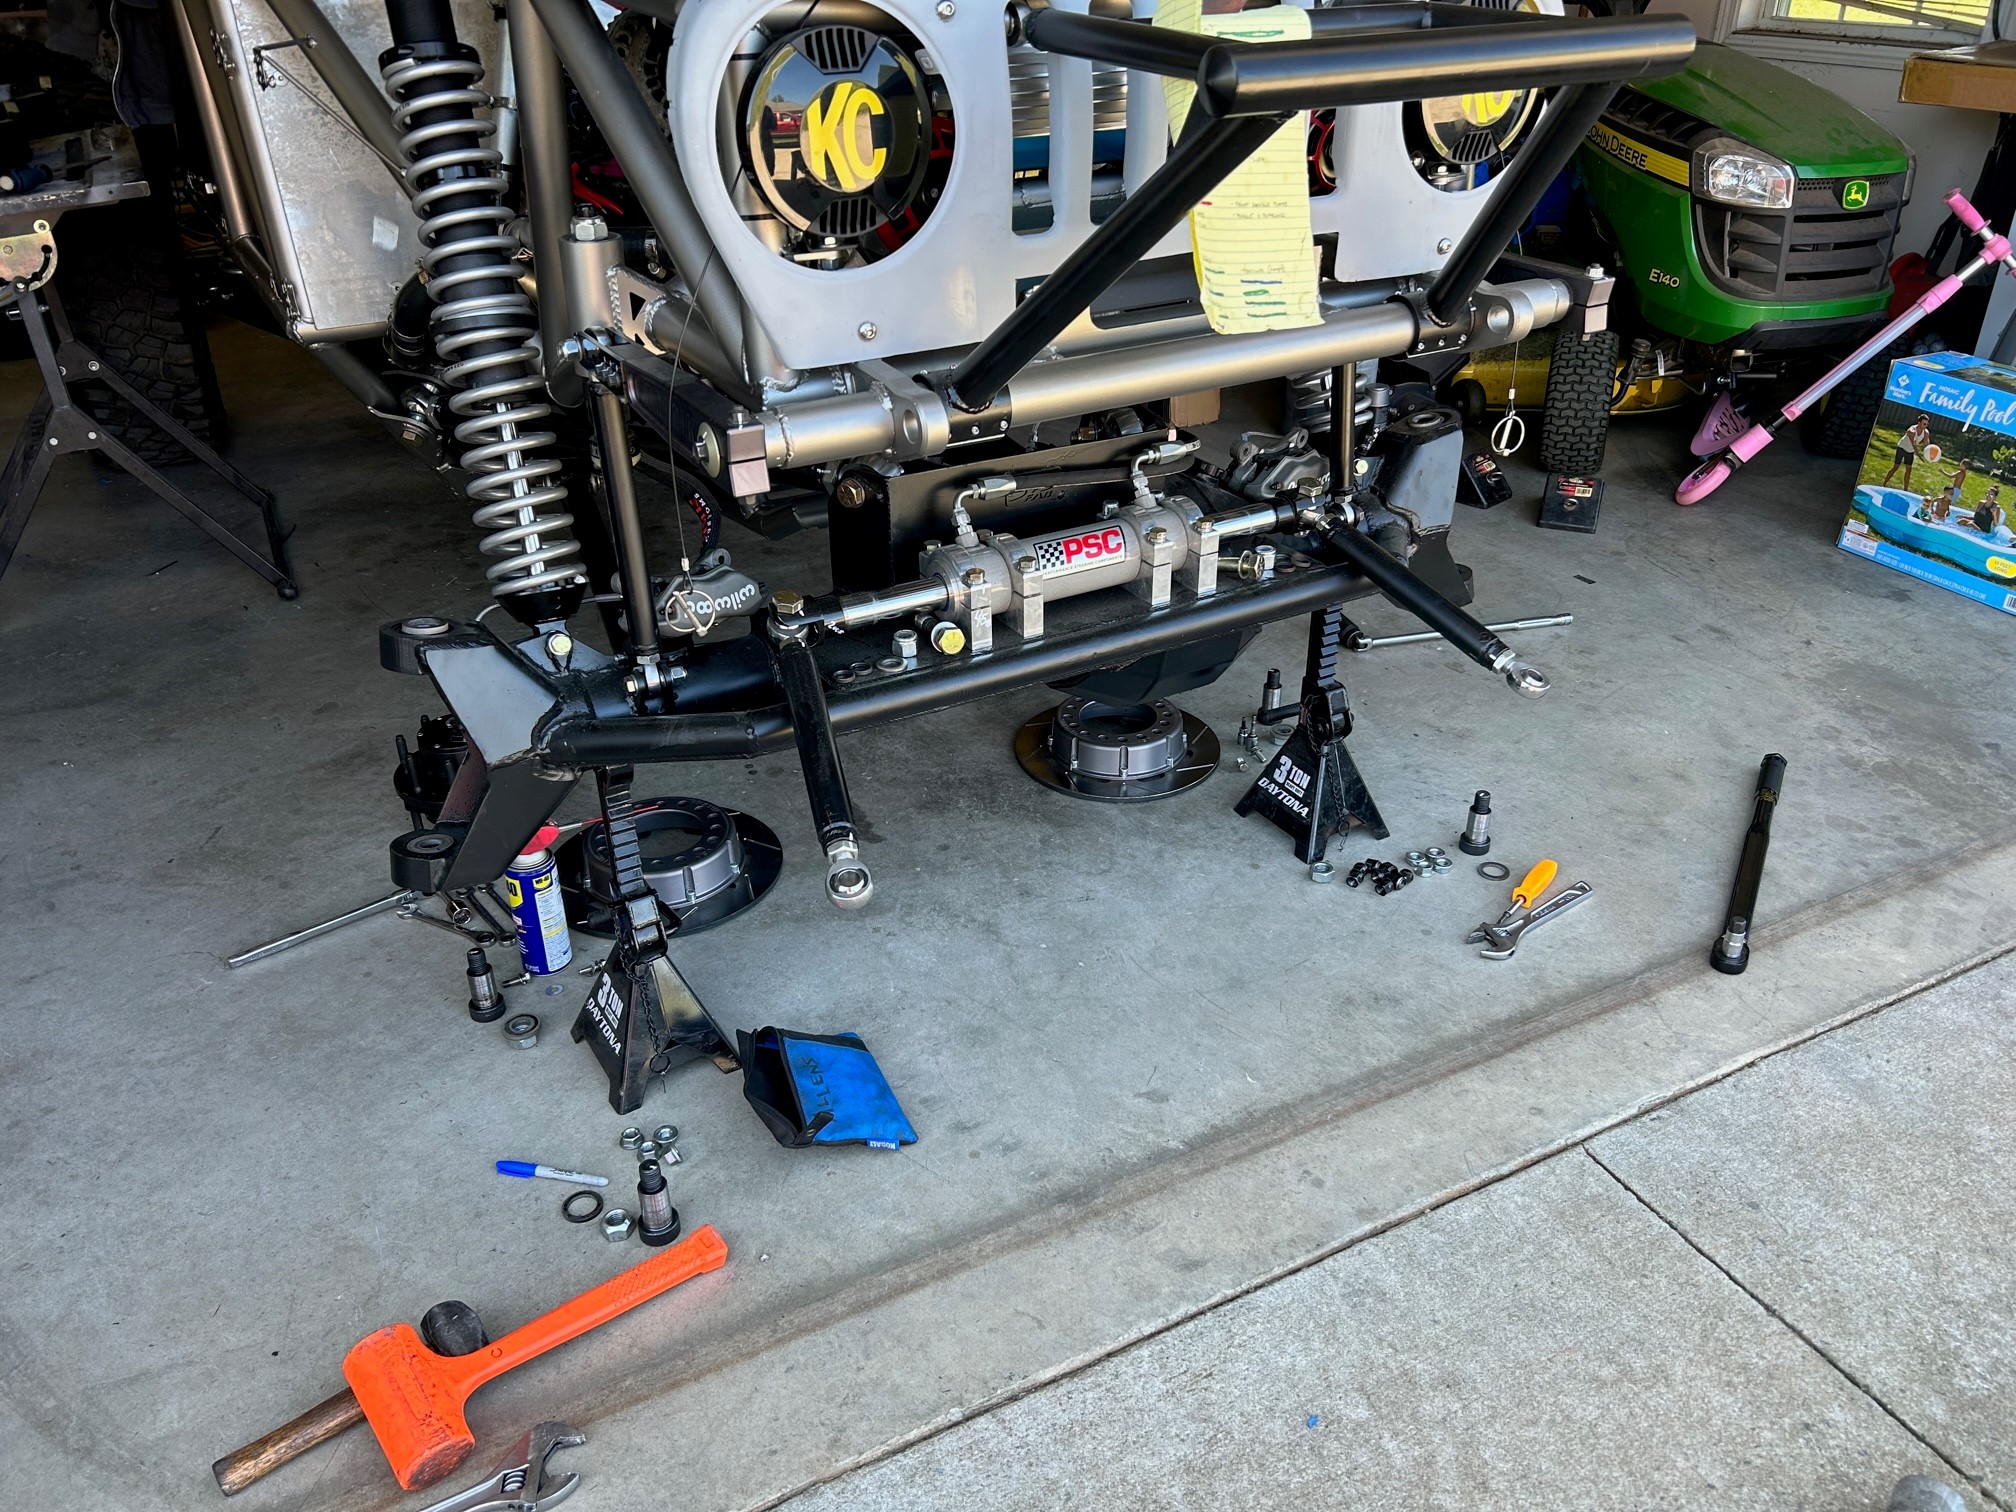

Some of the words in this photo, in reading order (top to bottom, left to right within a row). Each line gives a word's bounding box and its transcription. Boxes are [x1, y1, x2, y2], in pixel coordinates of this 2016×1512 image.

[806, 82, 887, 188] KC
[1610, 134, 1648, 168] DEERE
[1648, 268, 1680, 288] E140
[1918, 381, 1978, 433] Family
[1980, 398, 2016, 426] Pool
[1062, 529, 1122, 564] PSC
[1273, 755, 1292, 784] 3
[1288, 764, 1311, 790] TON
[1257, 776, 1309, 819] DAYTONA
[597, 972, 611, 1008] 3
[608, 986, 624, 1019] TON
[586, 997, 622, 1057] DAYTONA
